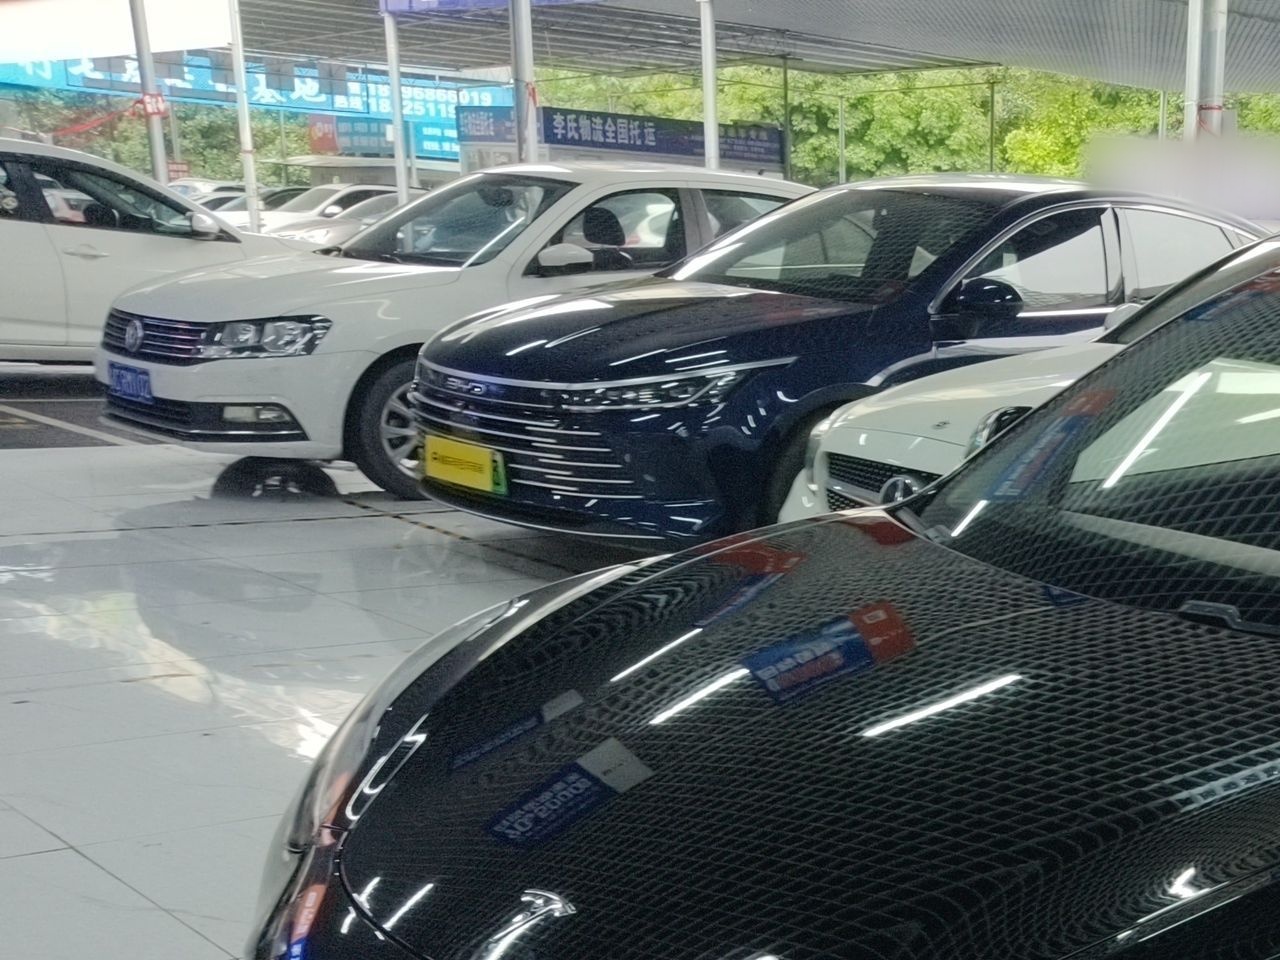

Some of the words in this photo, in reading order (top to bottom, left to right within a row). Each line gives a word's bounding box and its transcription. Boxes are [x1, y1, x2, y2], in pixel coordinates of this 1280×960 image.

[552, 111, 657, 146] 李氏物流全国托运
